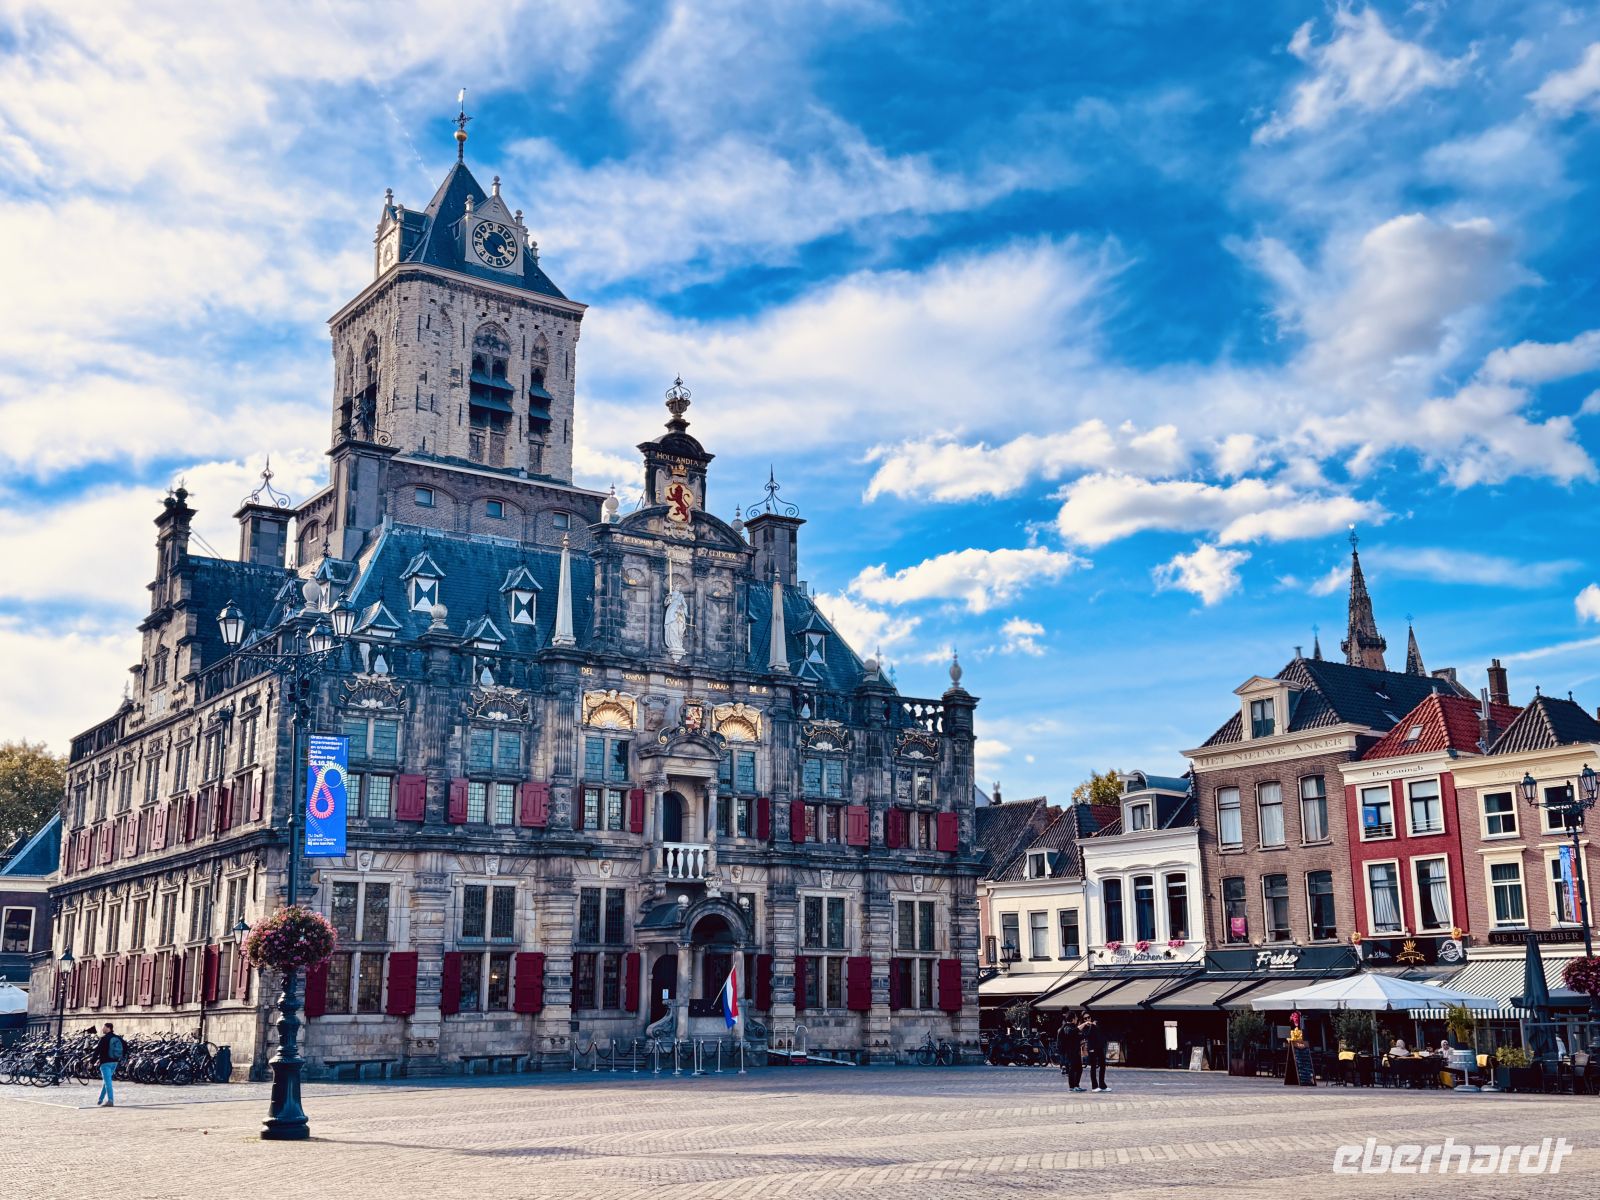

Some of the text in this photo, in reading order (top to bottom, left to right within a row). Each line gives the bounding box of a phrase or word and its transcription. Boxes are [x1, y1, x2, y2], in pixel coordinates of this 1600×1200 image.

[1201, 737, 1343, 768] HET NIEUWE ANKER
